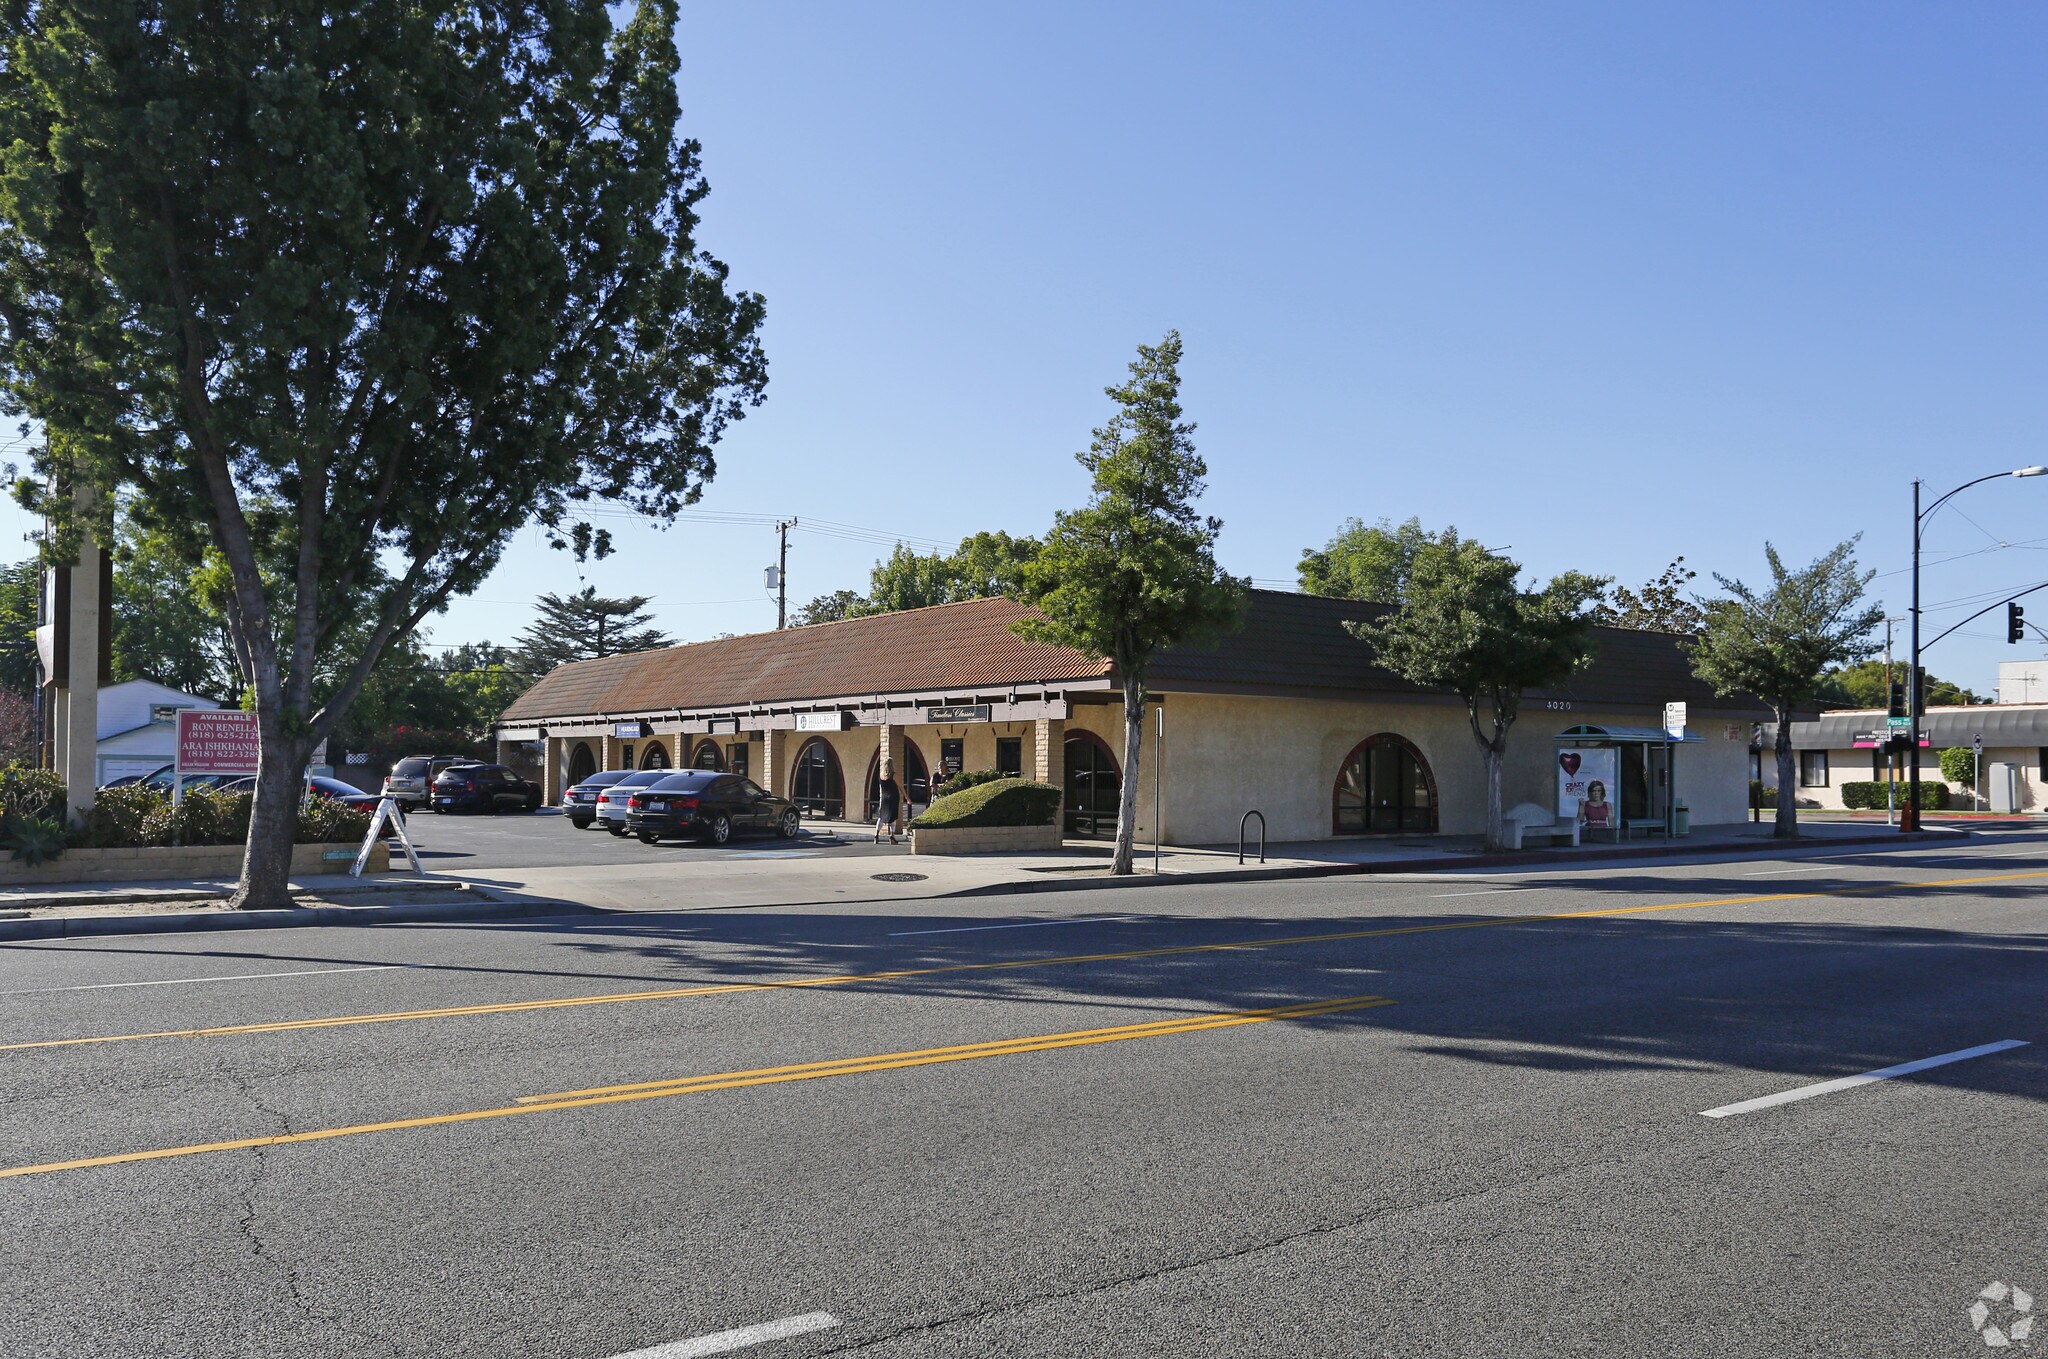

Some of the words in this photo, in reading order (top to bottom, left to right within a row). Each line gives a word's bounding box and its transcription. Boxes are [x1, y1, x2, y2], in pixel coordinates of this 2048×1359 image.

[952, 708, 975, 718] Classics
[808, 714, 837, 729] HILLCREST
[1887, 718, 1902, 726] Pass
[192, 723, 214, 731] RON
[216, 724, 258, 732] RENELLA
[188, 731, 215, 740] (818)
[182, 742, 202, 750] ARA
[187, 750, 214, 758] (818)
